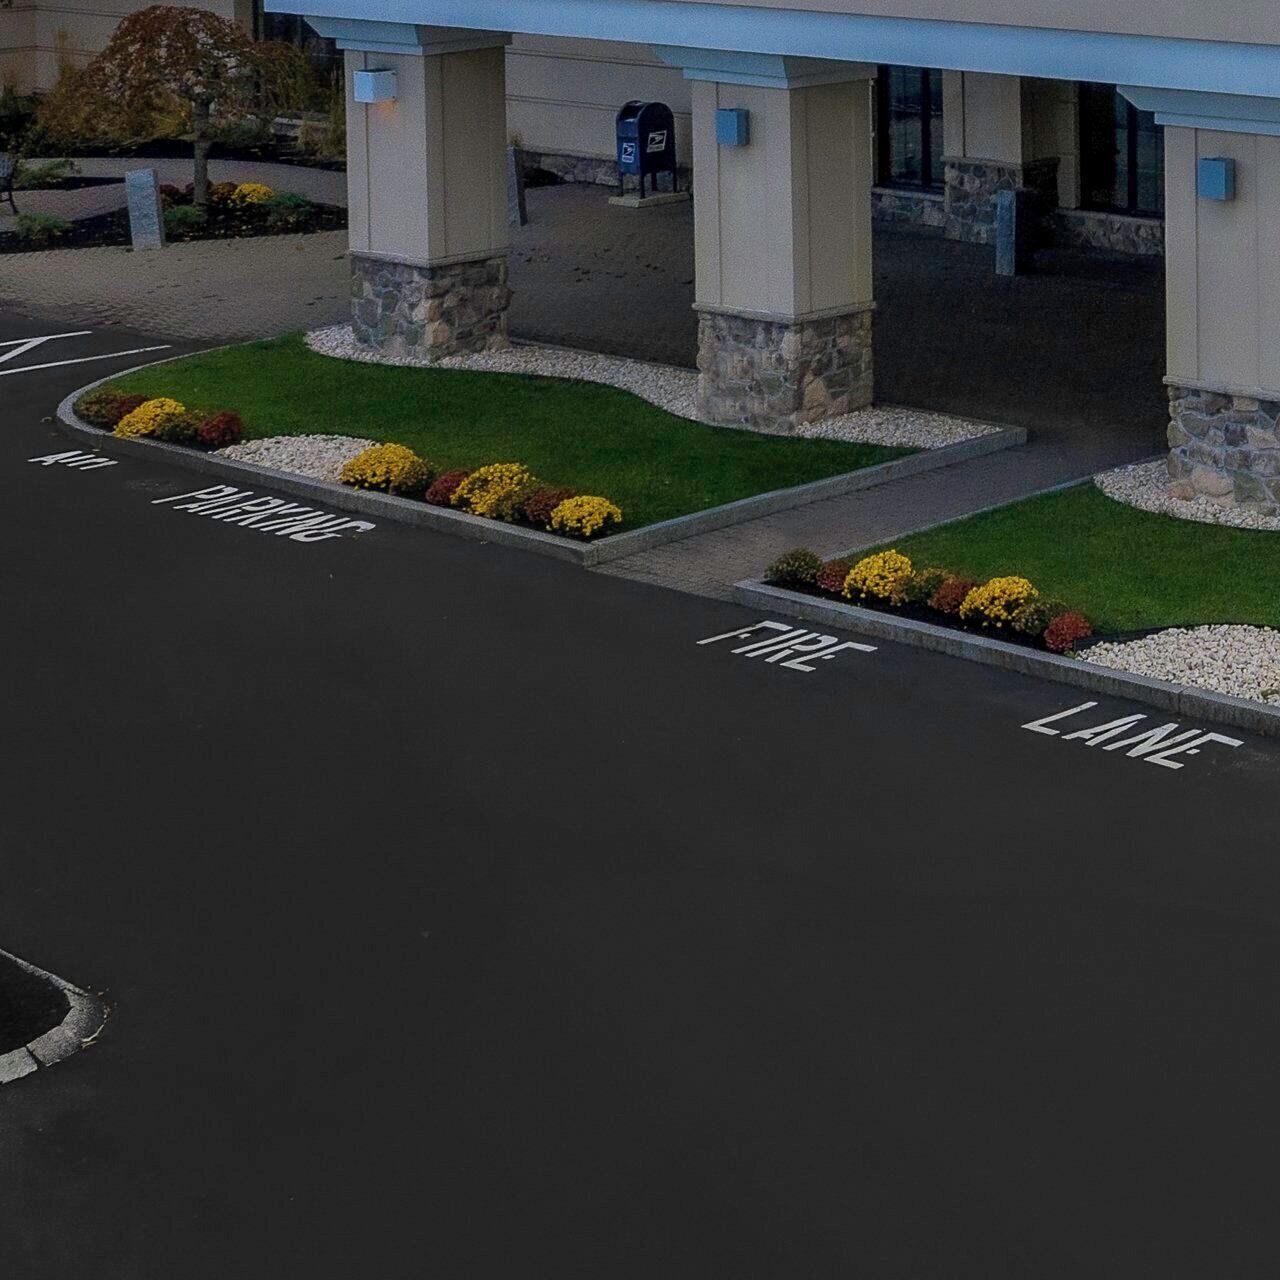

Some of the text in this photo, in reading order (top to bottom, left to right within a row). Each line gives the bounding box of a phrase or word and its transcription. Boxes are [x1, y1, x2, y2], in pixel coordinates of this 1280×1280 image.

[151, 484, 376, 543] PARKING
[696, 620, 1245, 769] FIRE LANE
